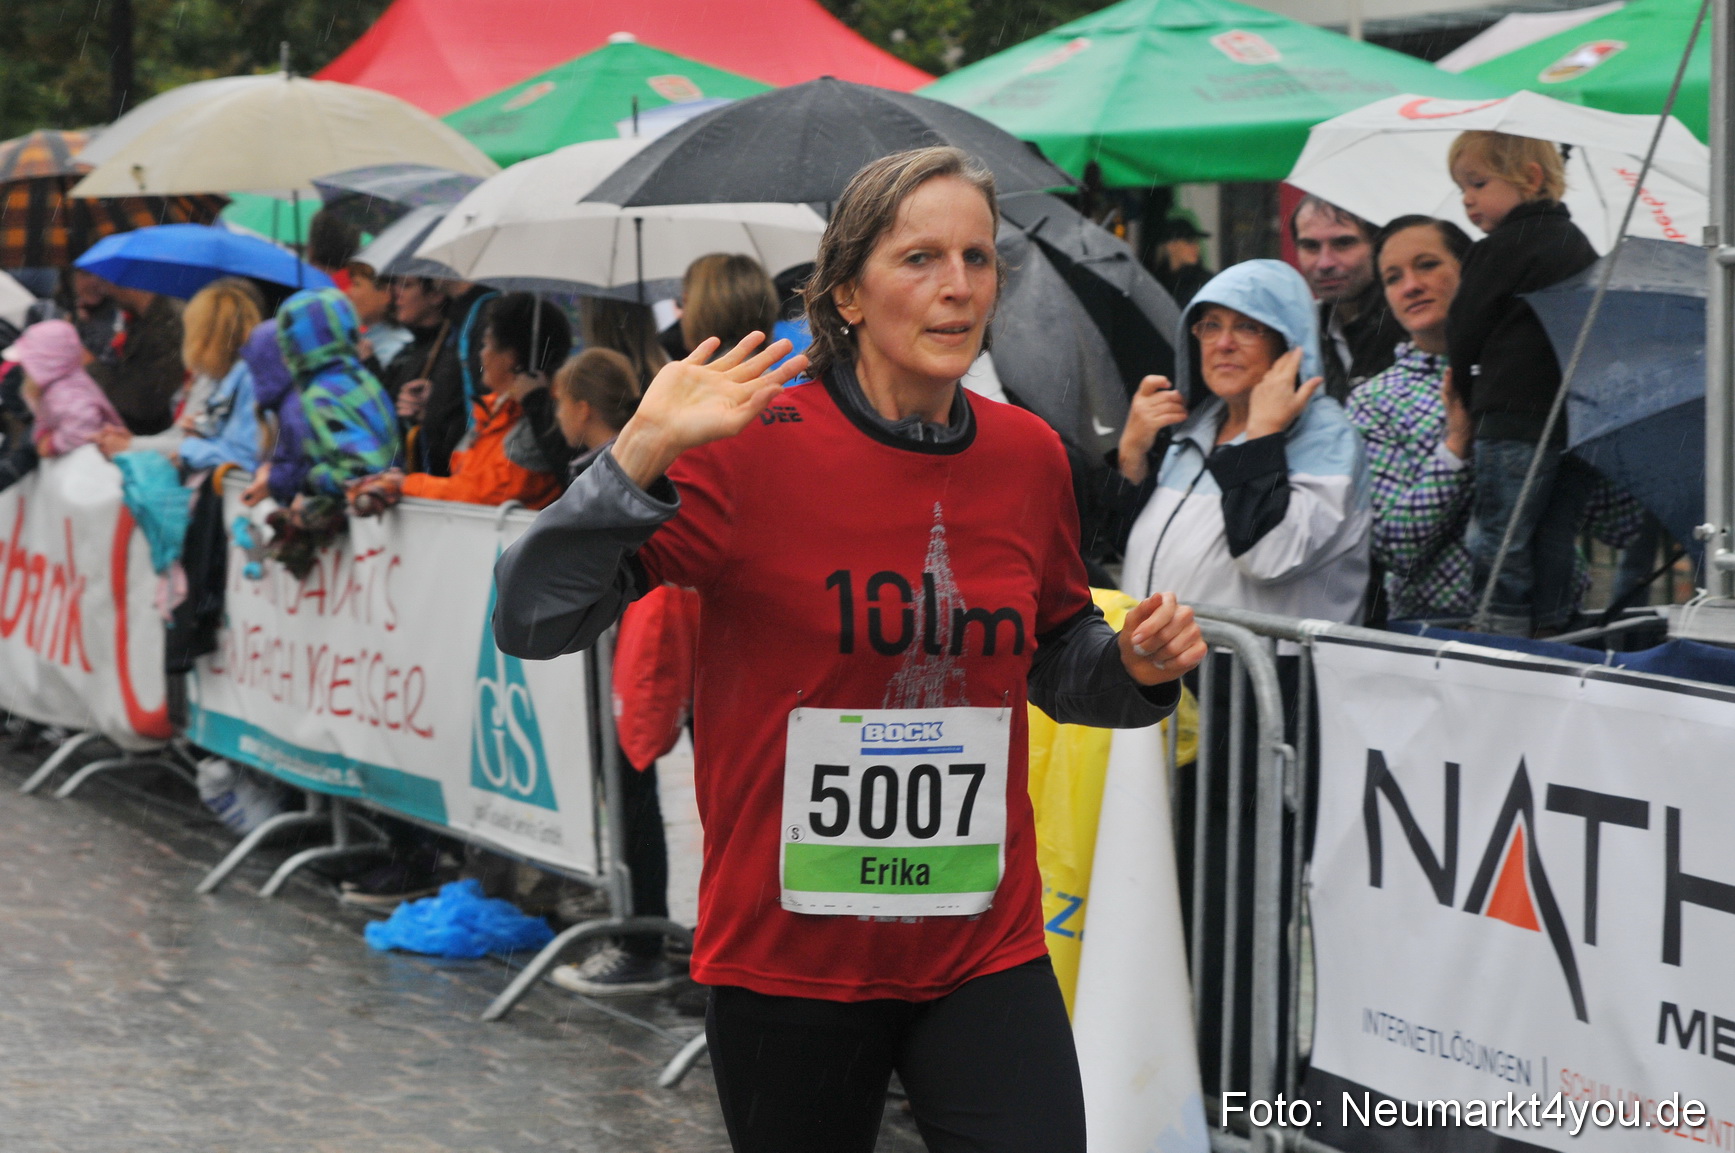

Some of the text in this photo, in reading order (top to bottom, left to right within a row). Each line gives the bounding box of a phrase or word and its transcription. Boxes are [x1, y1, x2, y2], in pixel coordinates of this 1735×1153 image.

[0, 496, 93, 674] bank
[861, 721, 944, 742] BOCK
[809, 763, 986, 839] 5007
[860, 857, 930, 886] Erika
[1362, 1007, 1532, 1088] INTERNETLÖSUNGEN
